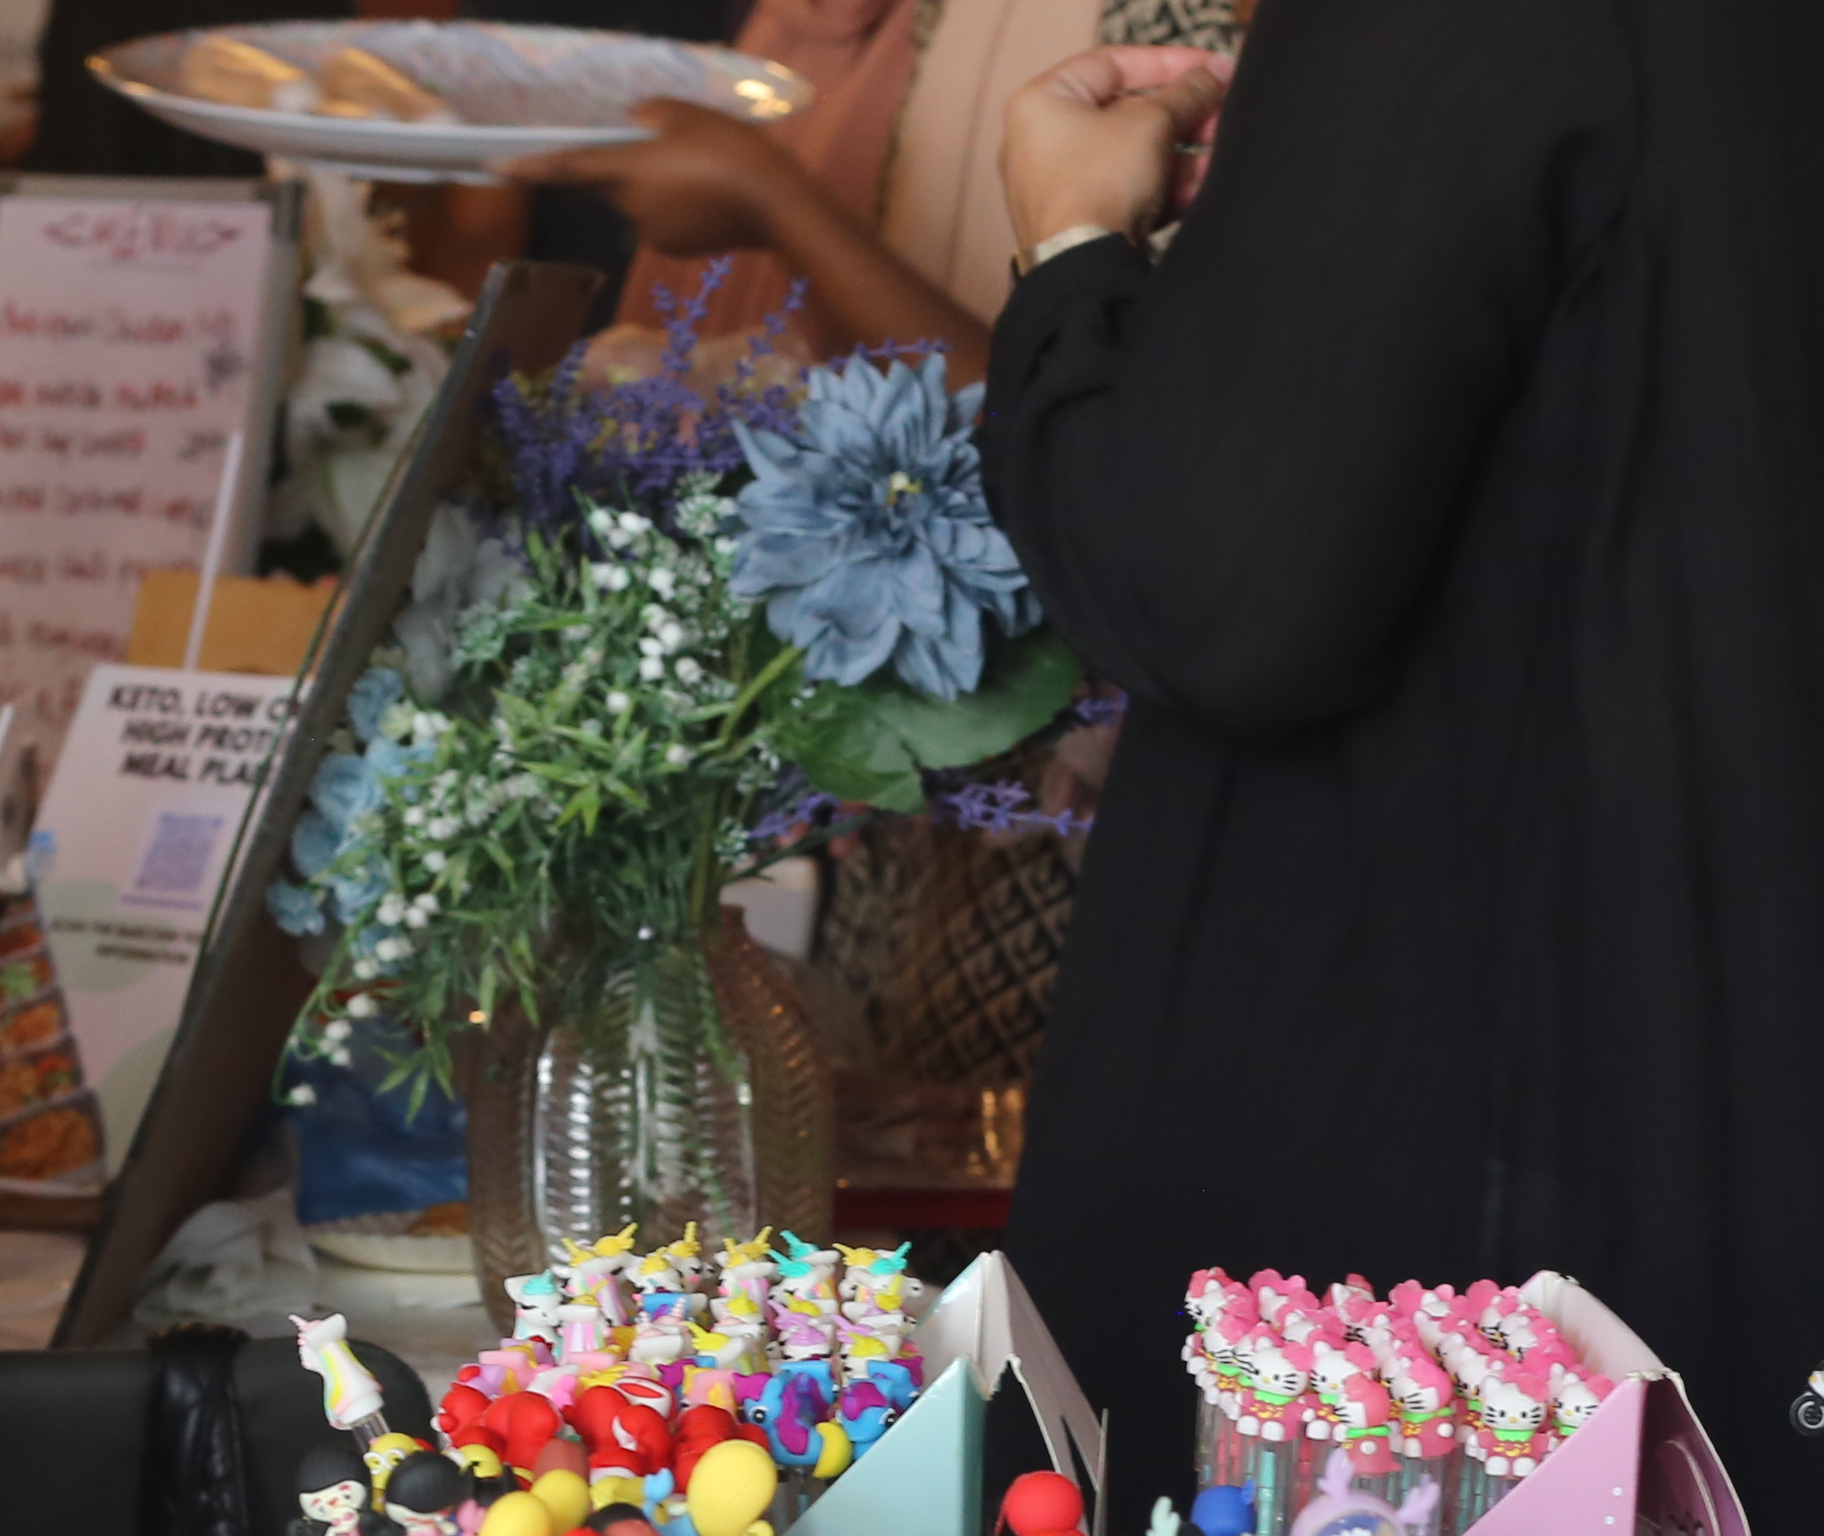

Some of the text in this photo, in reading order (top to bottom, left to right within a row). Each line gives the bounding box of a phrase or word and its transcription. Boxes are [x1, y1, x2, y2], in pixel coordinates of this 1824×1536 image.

[107, 683, 185, 717] KETO,
[194, 690, 261, 718] LOW
[122, 718, 274, 752] HIGH PROT
[121, 751, 268, 786] MEAL PLA
